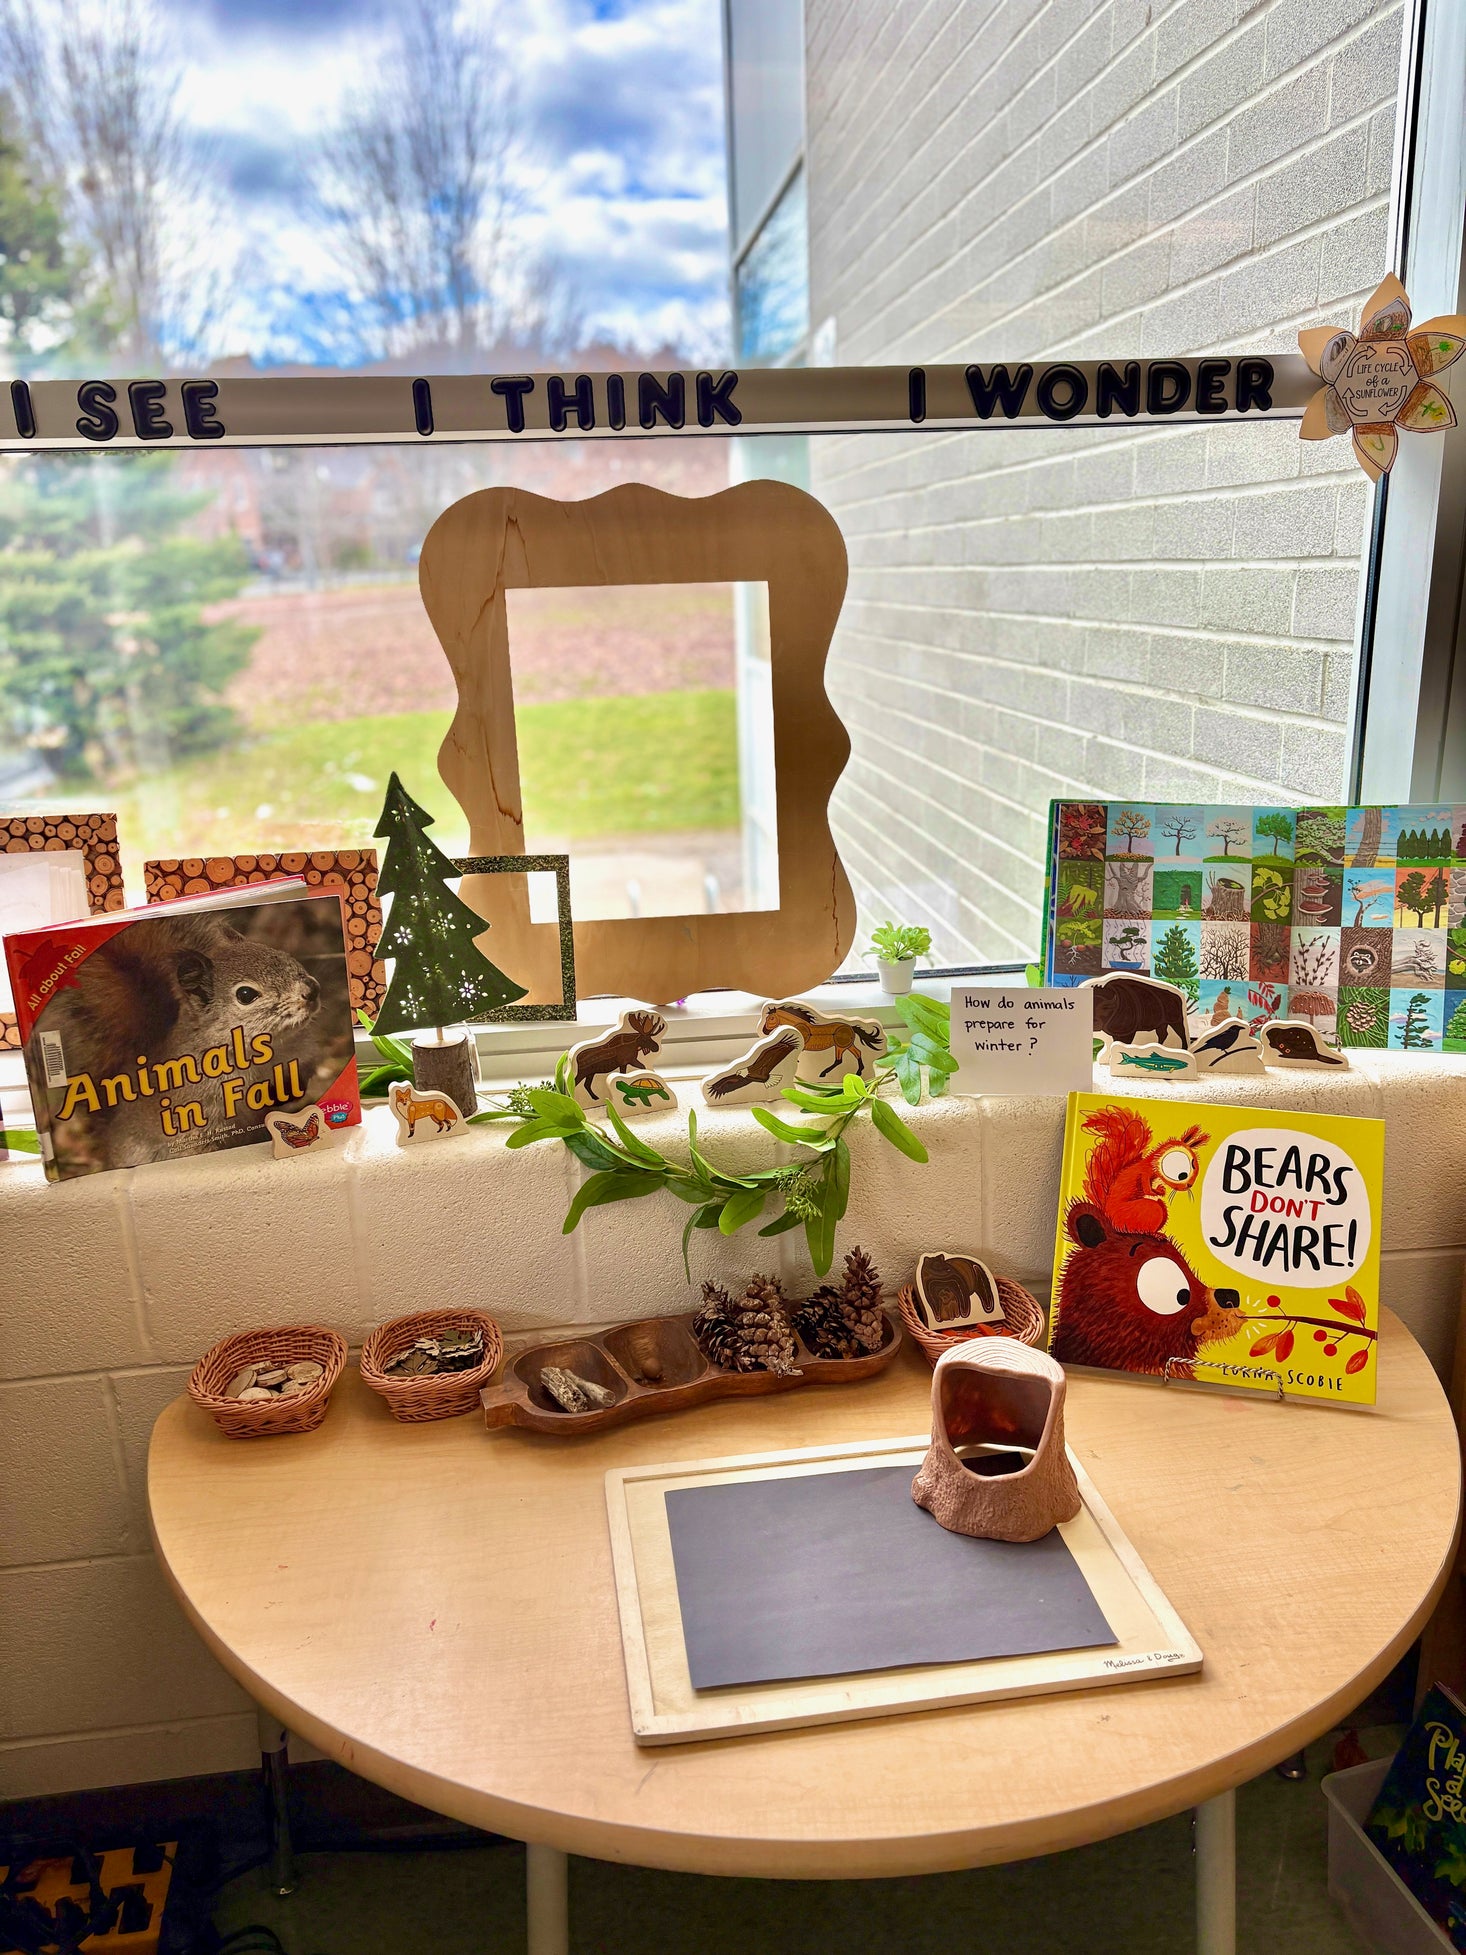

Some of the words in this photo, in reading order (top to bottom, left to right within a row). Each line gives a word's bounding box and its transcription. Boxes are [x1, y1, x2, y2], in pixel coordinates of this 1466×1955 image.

[1357, 364, 1372, 374] LIFE
[1374, 362, 1399, 373] CYCLE
[1365, 374, 1379, 388] of
[1381, 377, 1391, 385] a
[411, 378, 434, 436] I
[490, 370, 742, 433] THINK
[908, 367, 926, 423] I
[964, 357, 1275, 421] WONDER
[1355, 387, 1399, 399] SUNFLOWER
[10, 379, 36, 439] I
[76, 380, 226, 441] SEE
[27, 993, 42, 1011] All
[40, 962, 68, 994] about
[63, 944, 87, 964] Fall
[965, 996, 991, 1009] How
[997, 996, 1014, 1009] do
[1023, 998, 1075, 1010] animals
[964, 1019, 1015, 1033] prepare
[1025, 1017, 1046, 1029] for
[974, 1038, 1022, 1051] winter
[55, 1025, 274, 1121] Animals
[160, 1098, 208, 1136] in
[222, 1058, 305, 1119] Fall
[321, 1102, 349, 1114] ebble
[1222, 1144, 1353, 1205] BEARS
[1250, 1190, 1325, 1221] DON'T
[1209, 1205, 1357, 1272] SHARE!
[1287, 1369, 1343, 1391] SCOBIE
[1103, 1658, 1144, 1669] Melissa
[1424, 1721, 1466, 1778] Pla
